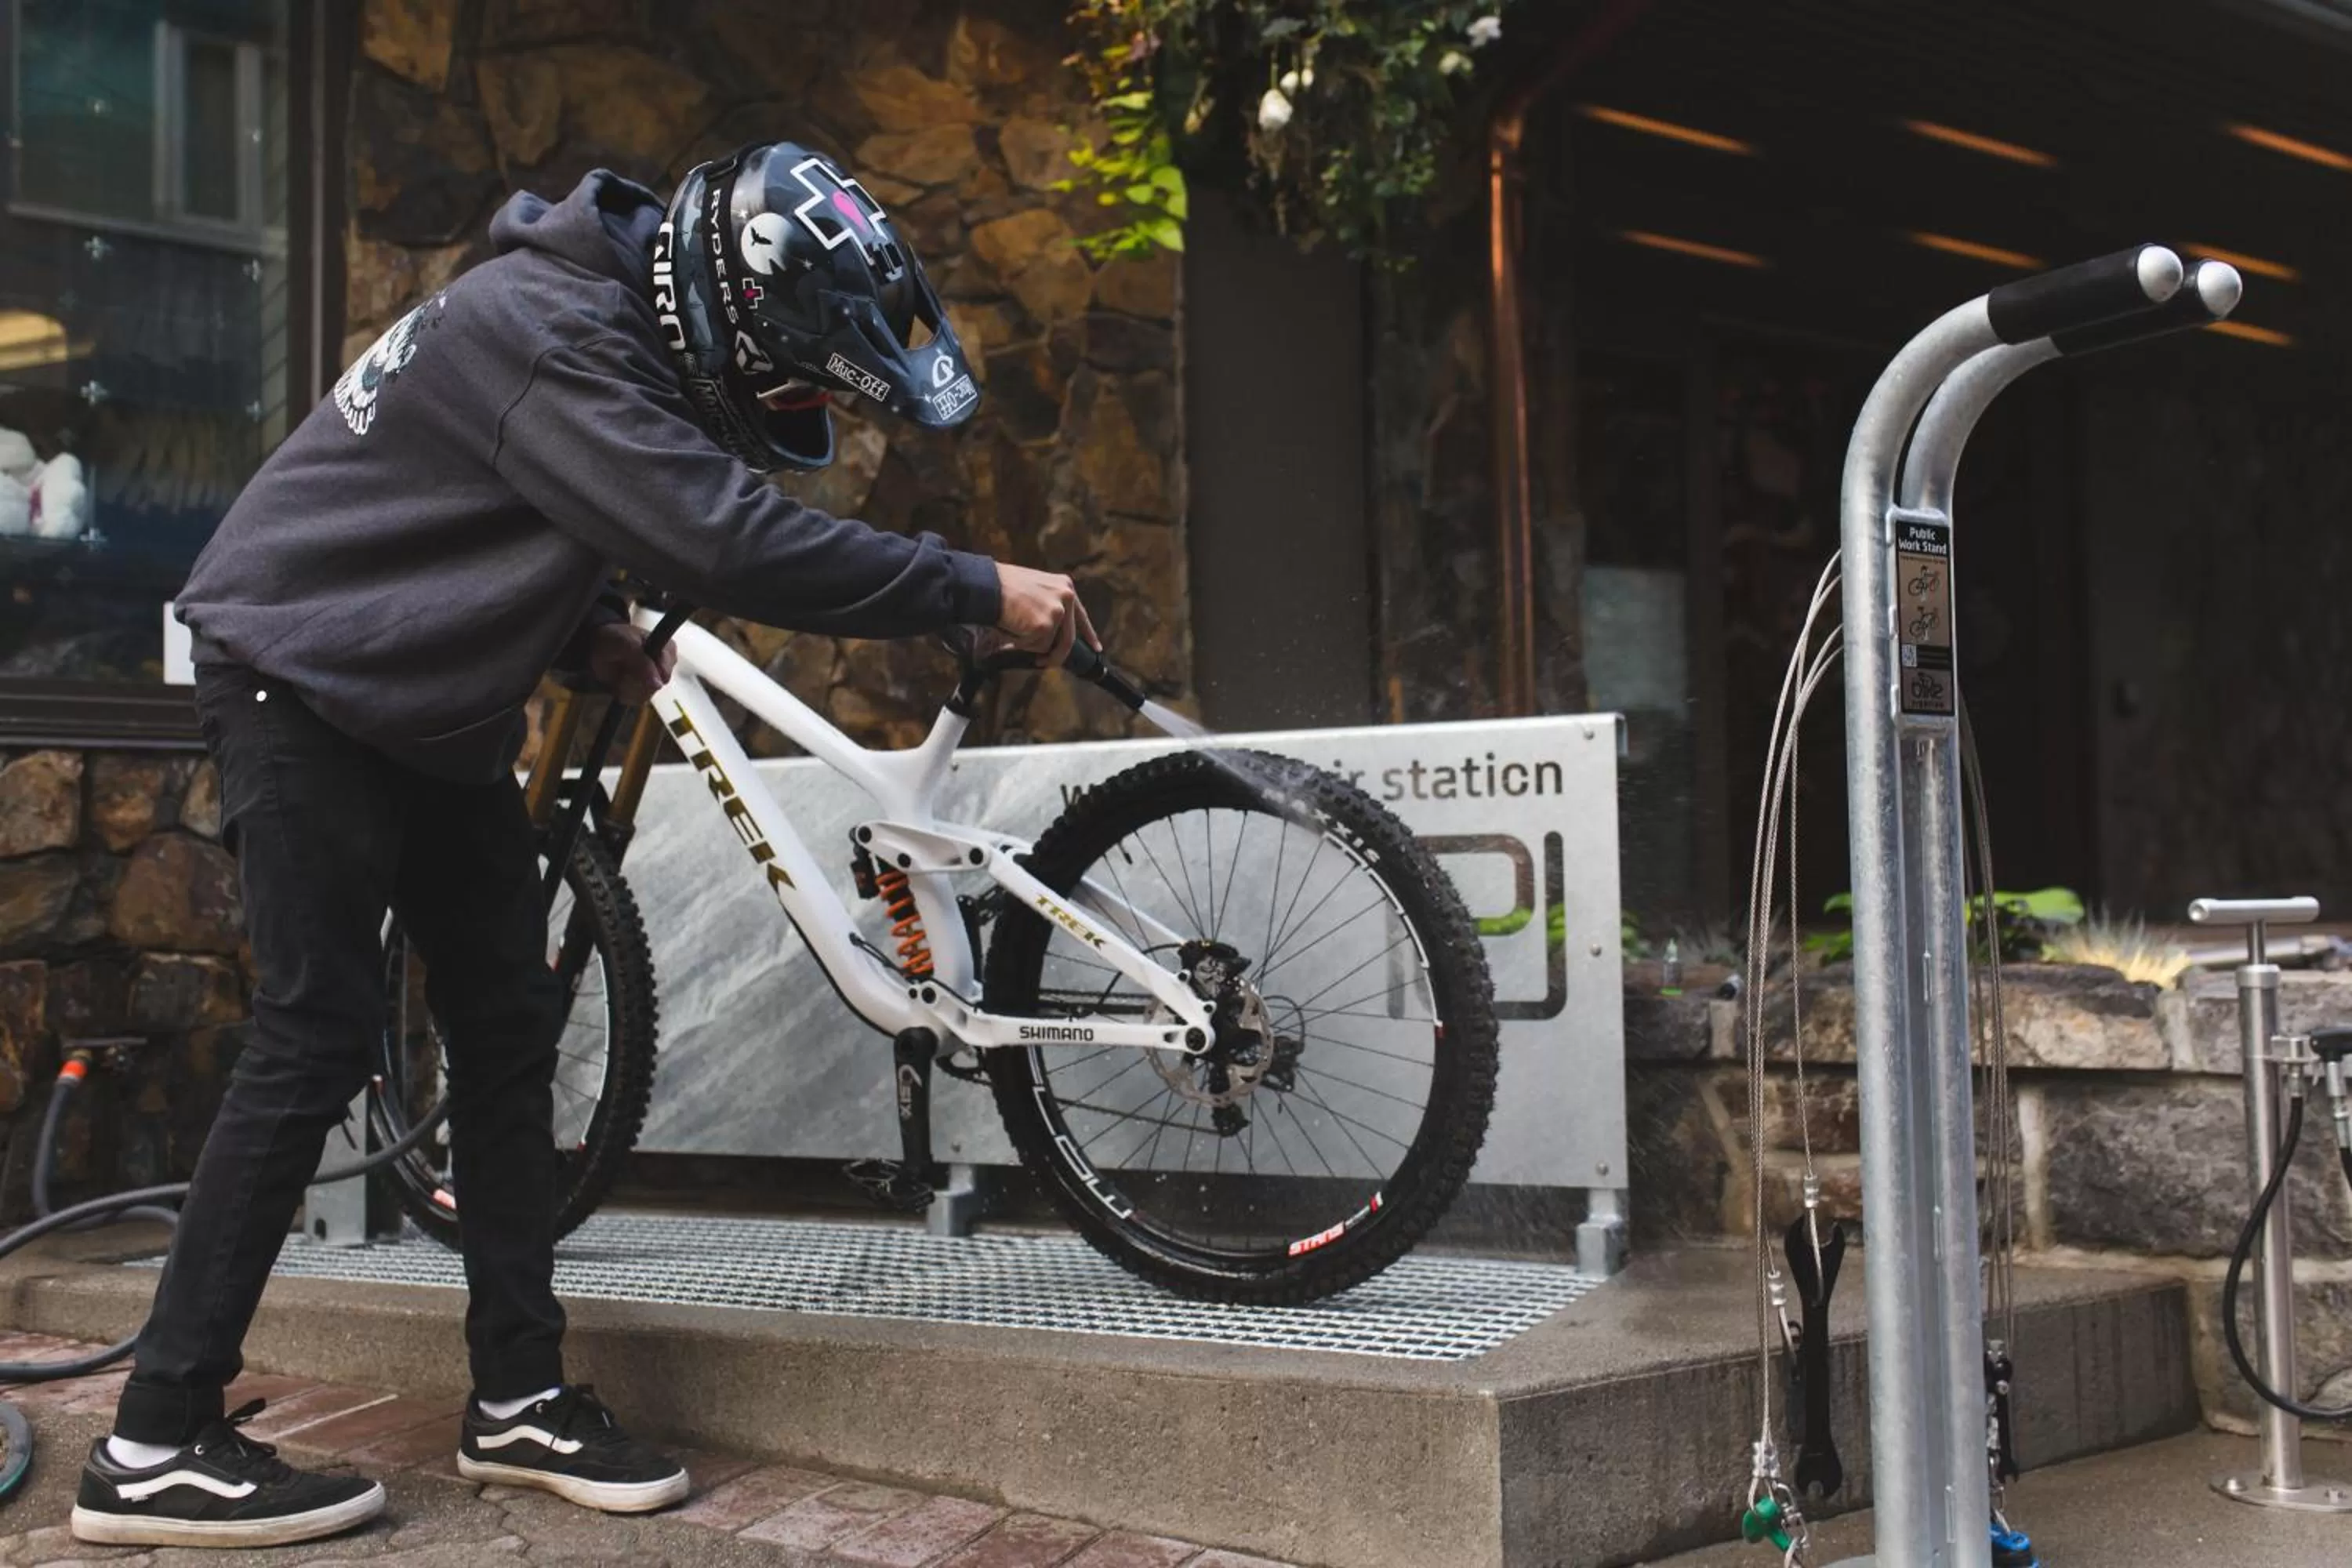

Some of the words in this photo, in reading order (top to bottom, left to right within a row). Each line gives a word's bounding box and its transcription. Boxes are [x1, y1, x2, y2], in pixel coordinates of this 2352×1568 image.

[710, 189, 739, 324] RYDERS
[653, 222, 686, 350] GIRO
[1898, 539, 1920, 550] Work
[1922, 541, 1947, 554] Stand
[1910, 527, 1936, 540] Public
[669, 699, 797, 902] TREK
[1382, 750, 1563, 801] station
[1036, 894, 1106, 951] TREK
[1019, 1025, 1094, 1042] SHIMANO
